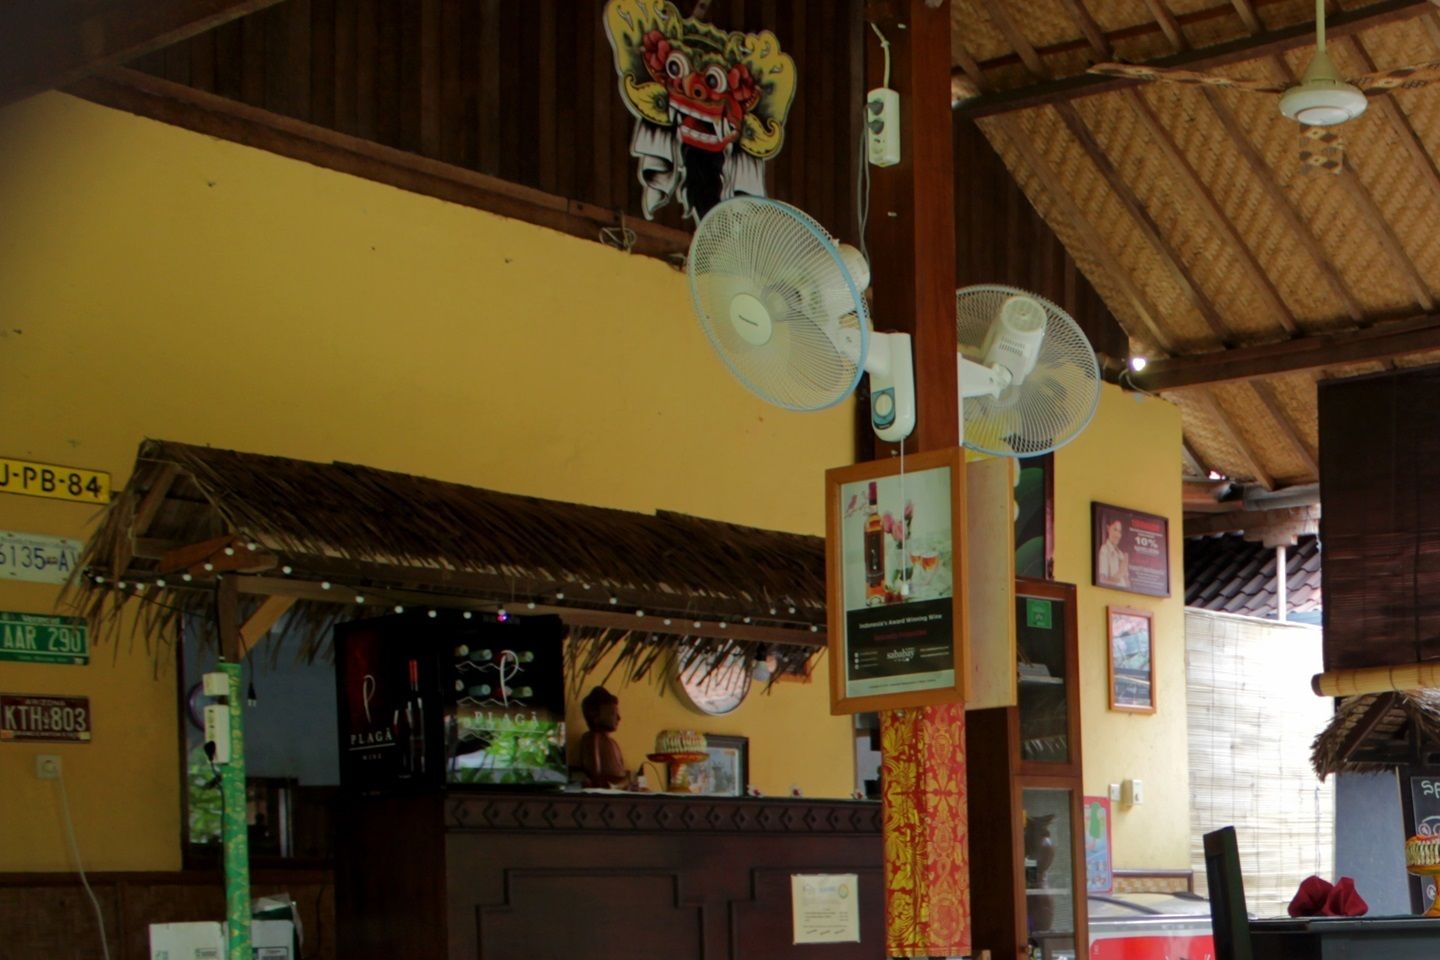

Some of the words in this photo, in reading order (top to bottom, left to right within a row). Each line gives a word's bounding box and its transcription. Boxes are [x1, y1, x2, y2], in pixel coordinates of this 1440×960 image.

[4, 625, 37, 650] AAR
[4, 704, 42, 731] KTH
[50, 706, 87, 732] 803
